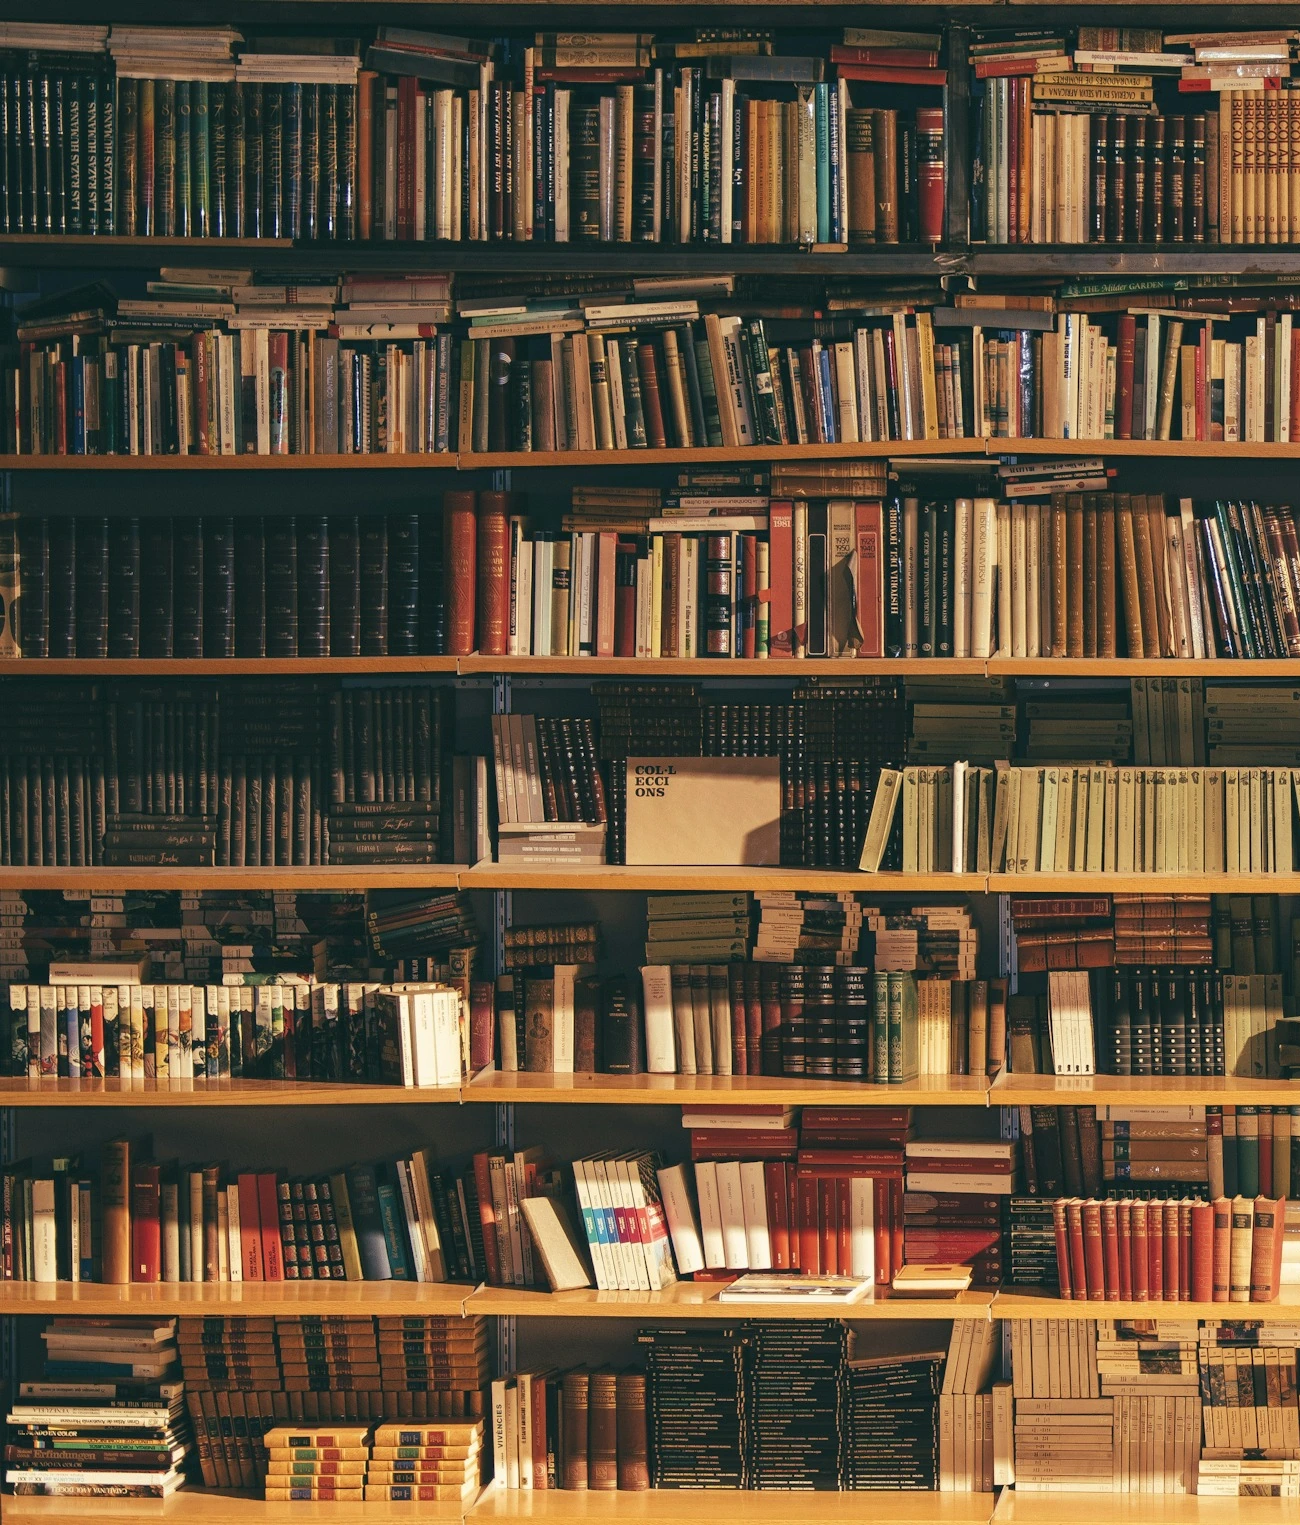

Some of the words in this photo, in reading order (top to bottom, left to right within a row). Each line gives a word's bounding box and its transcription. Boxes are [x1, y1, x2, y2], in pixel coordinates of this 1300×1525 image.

[1053, 76, 1084, 84] HOMBRES
[1086, 76, 1094, 85] DE
[1097, 77, 1141, 86] DEVORADORES
[1050, 88, 1078, 97] AFRICANA
[1080, 89, 1094, 97] SELVA
[1112, 91, 1136, 99] CACERIAS
[71, 102, 79, 152] HUMANAS
[88, 102, 96, 154] HUMANAS
[104, 103, 112, 154] HUMANAS
[1233, 99, 1242, 174] BRICOLAJE
[1245, 99, 1254, 174] BRICOLAJE
[1256, 99, 1265, 174] BRICOLAJE
[1267, 99, 1277, 174] BRICOLAJE
[71, 155, 79, 188] RAZAS
[88, 156, 96, 190] RAZAS
[104, 156, 112, 190] RAZAS
[72, 190, 80, 210] LAS
[88, 192, 97, 211] LAS
[104, 192, 112, 211] LAS
[1101, 284, 1126, 292] Milder
[1128, 281, 1163, 290] GARDEN
[889, 506, 898, 545] HOMBRE
[890, 548, 898, 567] DEL
[890, 569, 899, 614] HISTORIA
[635, 765, 676, 775] COL·L
[635, 776, 669, 786] ECCI
[635, 788, 665, 797] ONS
[34, 1450, 96, 1460] Erfindungen
